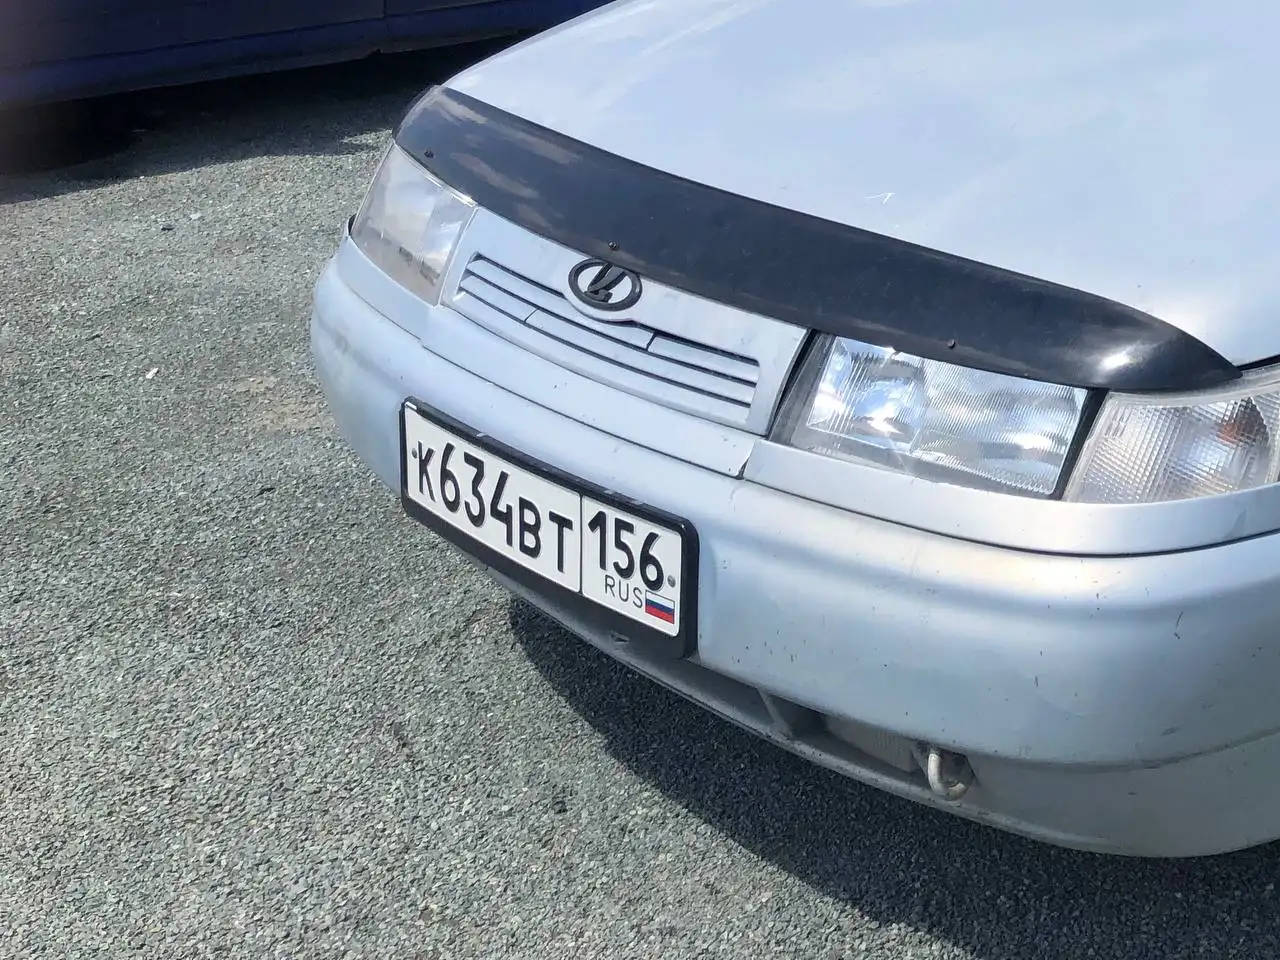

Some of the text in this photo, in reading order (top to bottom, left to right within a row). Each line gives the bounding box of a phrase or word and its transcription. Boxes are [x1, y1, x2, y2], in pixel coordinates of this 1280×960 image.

[417, 440, 665, 591] К634ВТ 156
[604, 574, 643, 609] RUS
